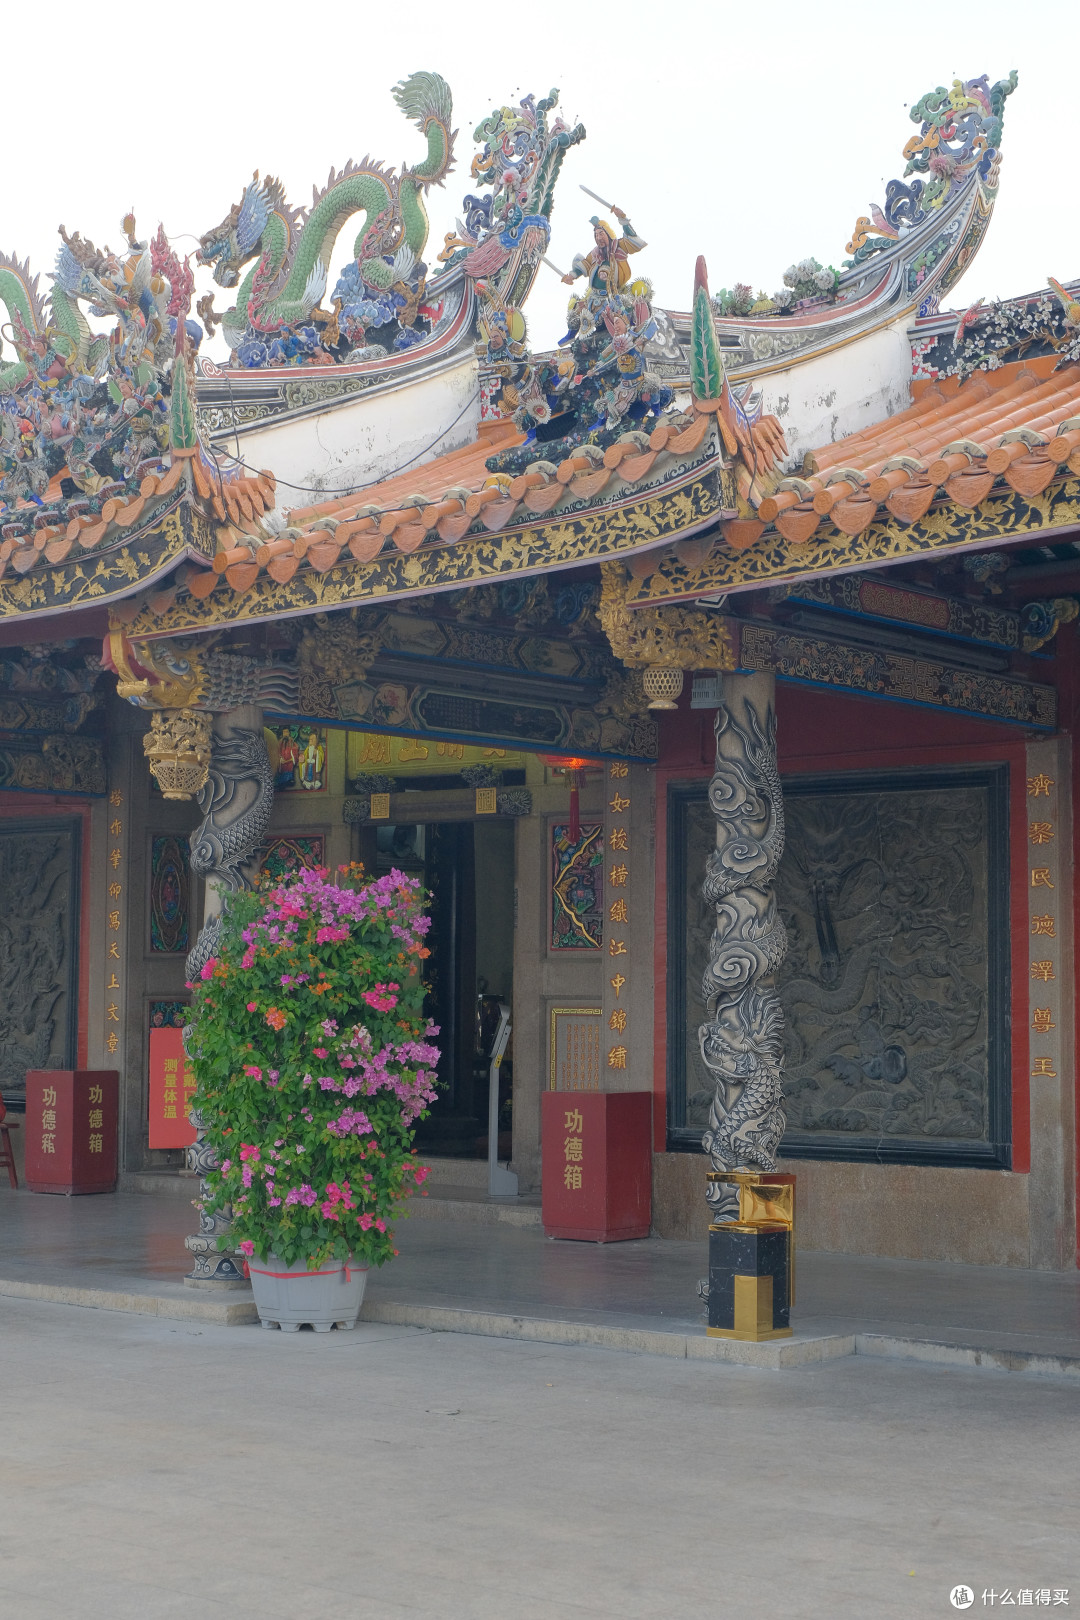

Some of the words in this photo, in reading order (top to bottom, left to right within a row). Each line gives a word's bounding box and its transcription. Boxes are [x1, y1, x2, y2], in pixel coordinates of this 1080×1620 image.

[41, 1085, 57, 1154] 功德箱
[87, 1084, 104, 1153] 功德箱
[163, 1058, 179, 1119] 测量体温
[182, 1058, 198, 1118] 戴口罩
[563, 1108, 584, 1190] 功德箱
